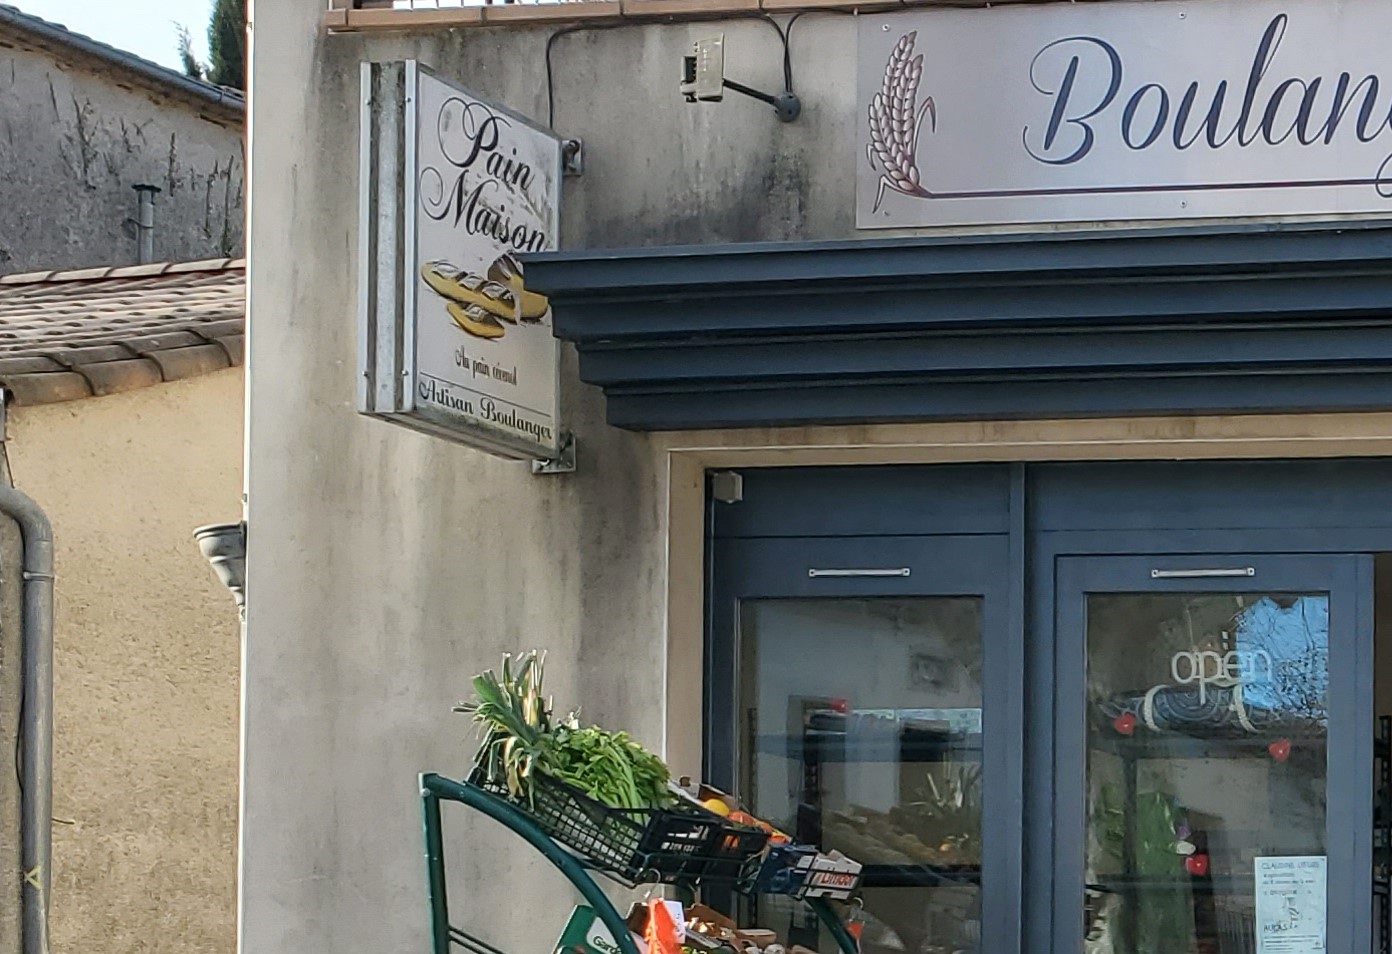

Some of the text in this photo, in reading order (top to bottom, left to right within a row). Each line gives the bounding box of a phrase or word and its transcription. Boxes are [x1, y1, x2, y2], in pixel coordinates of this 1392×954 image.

[437, 97, 536, 192] Pain
[420, 169, 547, 252] Maison
[455, 345, 470, 370] Au
[472, 357, 490, 379] pain
[418, 379, 552, 442] Artisan Boulanger
[1171, 650, 1273, 705] open
